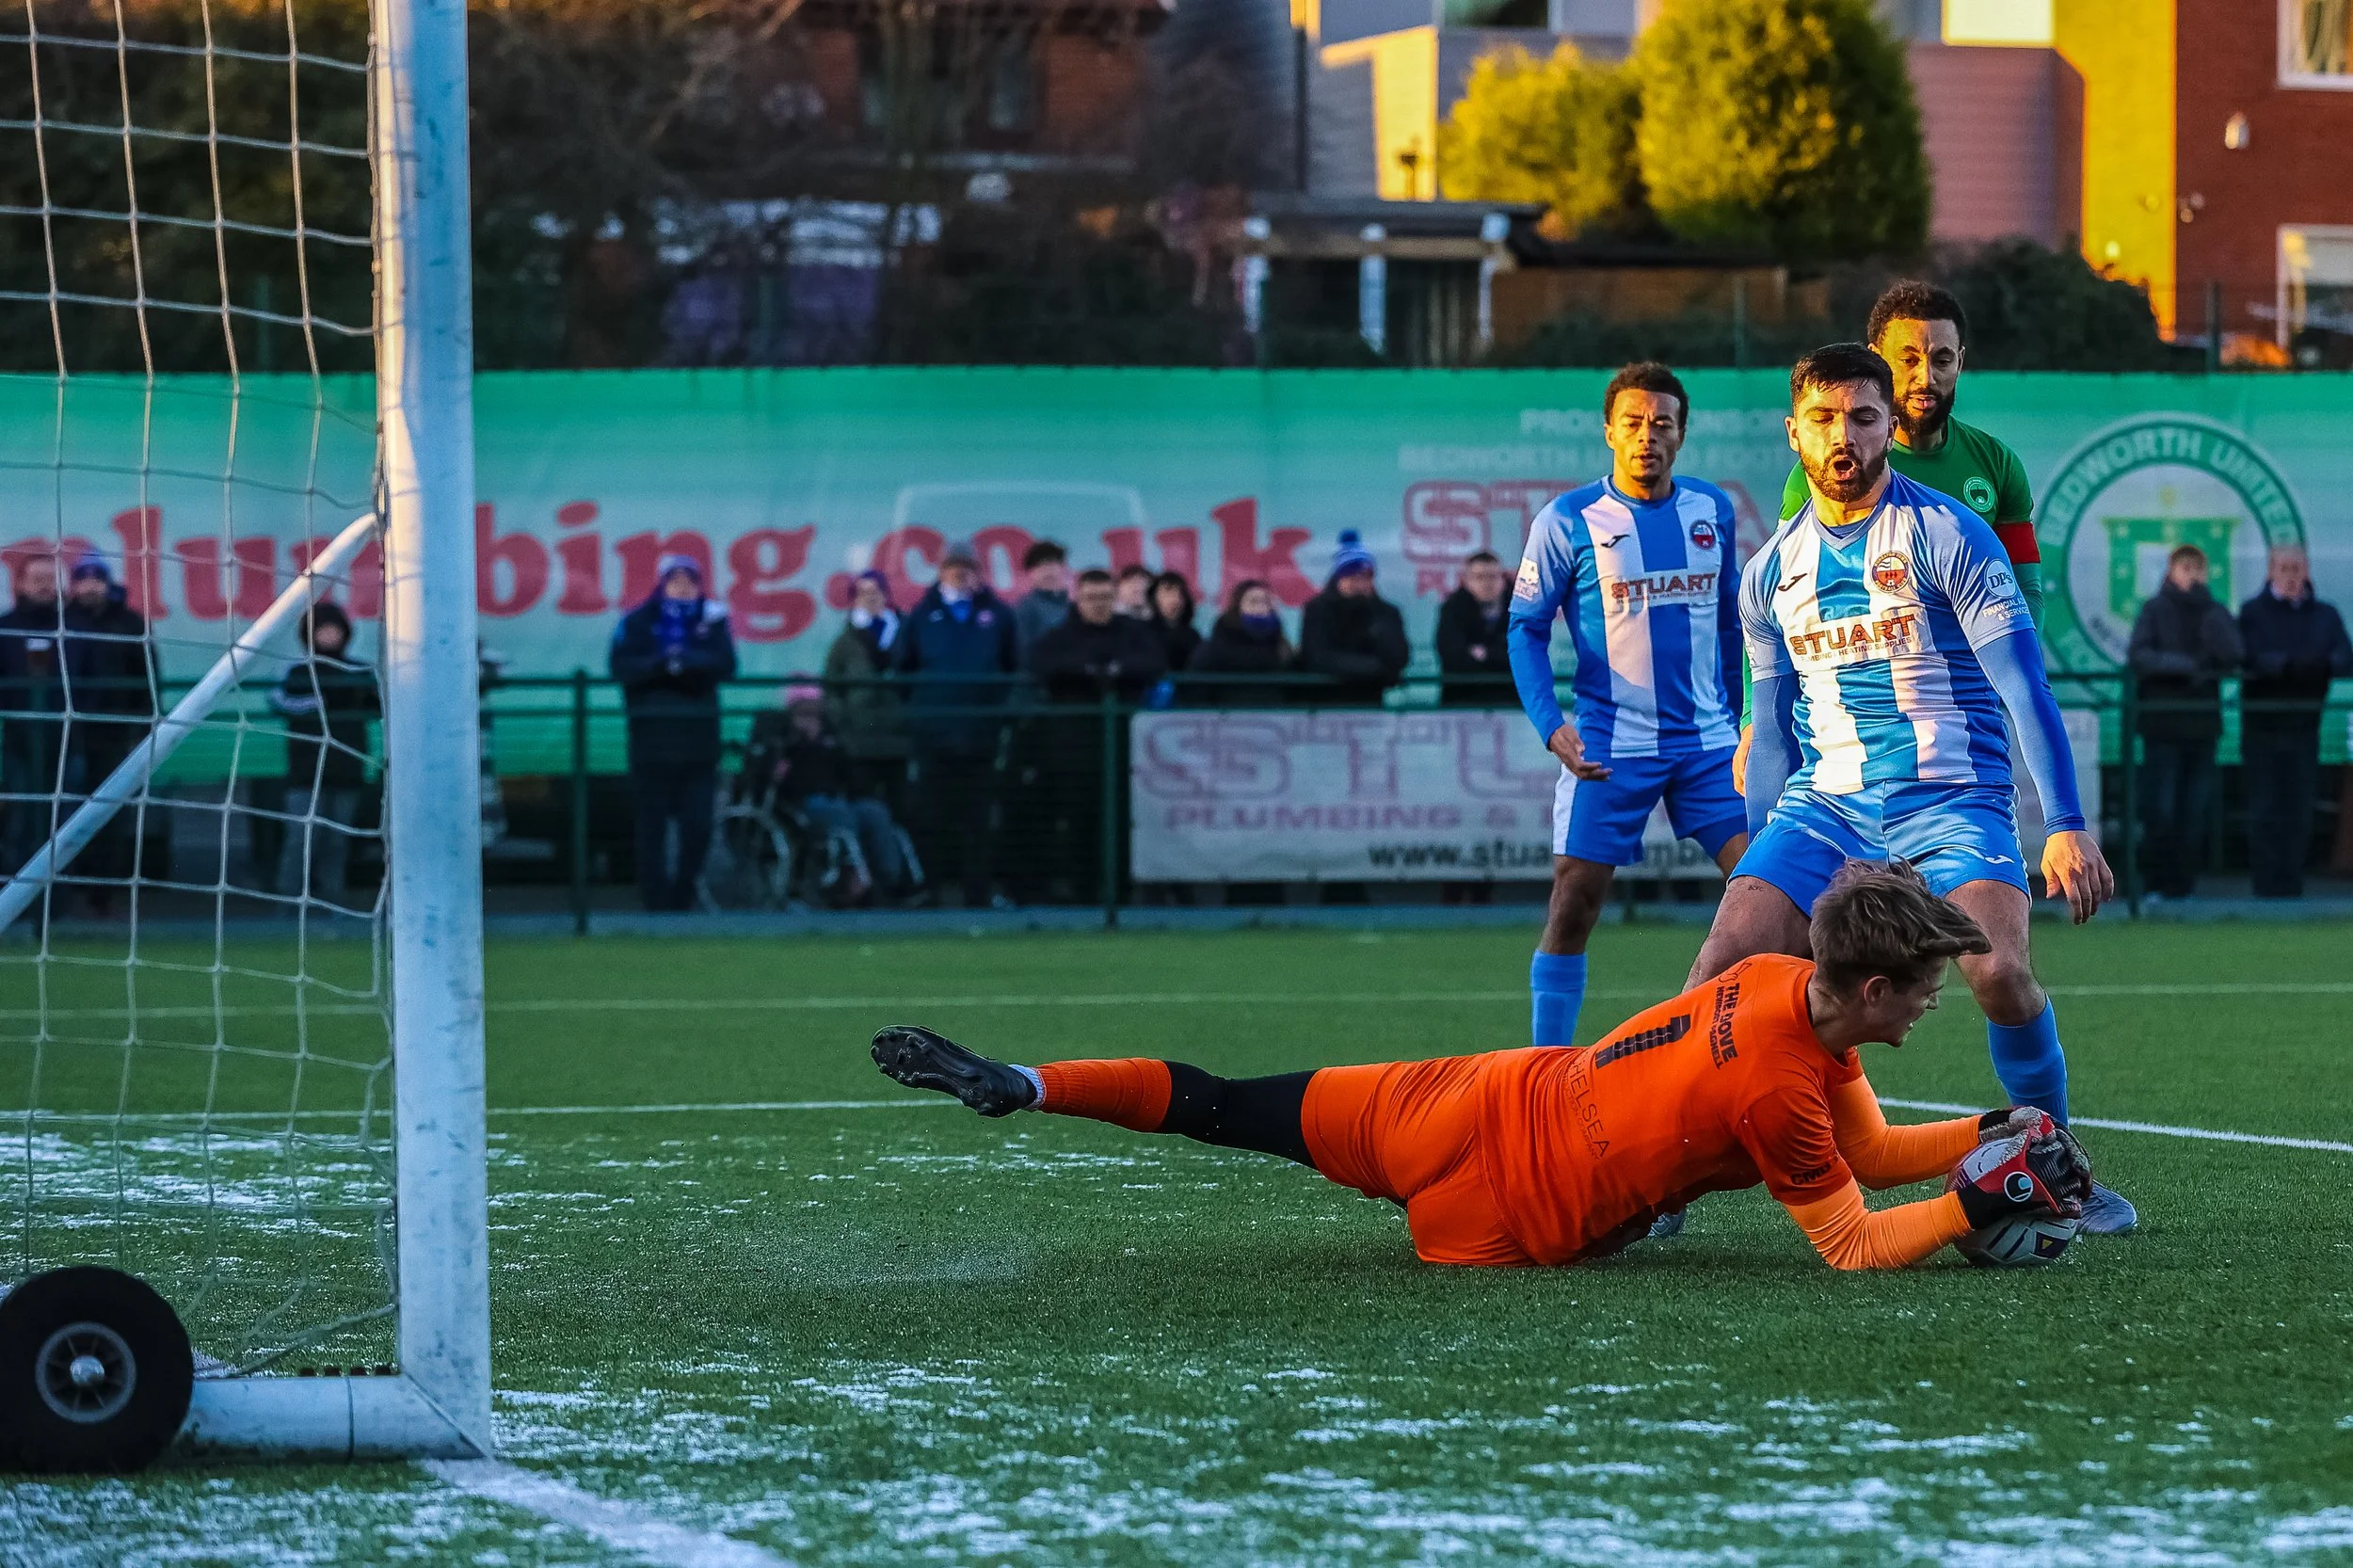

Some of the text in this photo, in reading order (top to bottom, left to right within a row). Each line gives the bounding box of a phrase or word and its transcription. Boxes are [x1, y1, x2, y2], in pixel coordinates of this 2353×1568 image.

[2037, 428, 2205, 548] BEDWORTH
[1611, 573, 1717, 599] STUART
[1988, 571, 2013, 589] DP's
[1982, 599, 2018, 617] FINANCIAL
[1789, 614, 1915, 656] STUART
[1164, 805, 1461, 830] PLUMBING
[1594, 1014, 1691, 1070] 1
[1717, 982, 1740, 1063] THE DOVE
[1569, 1060, 1610, 1158] HELSEA
